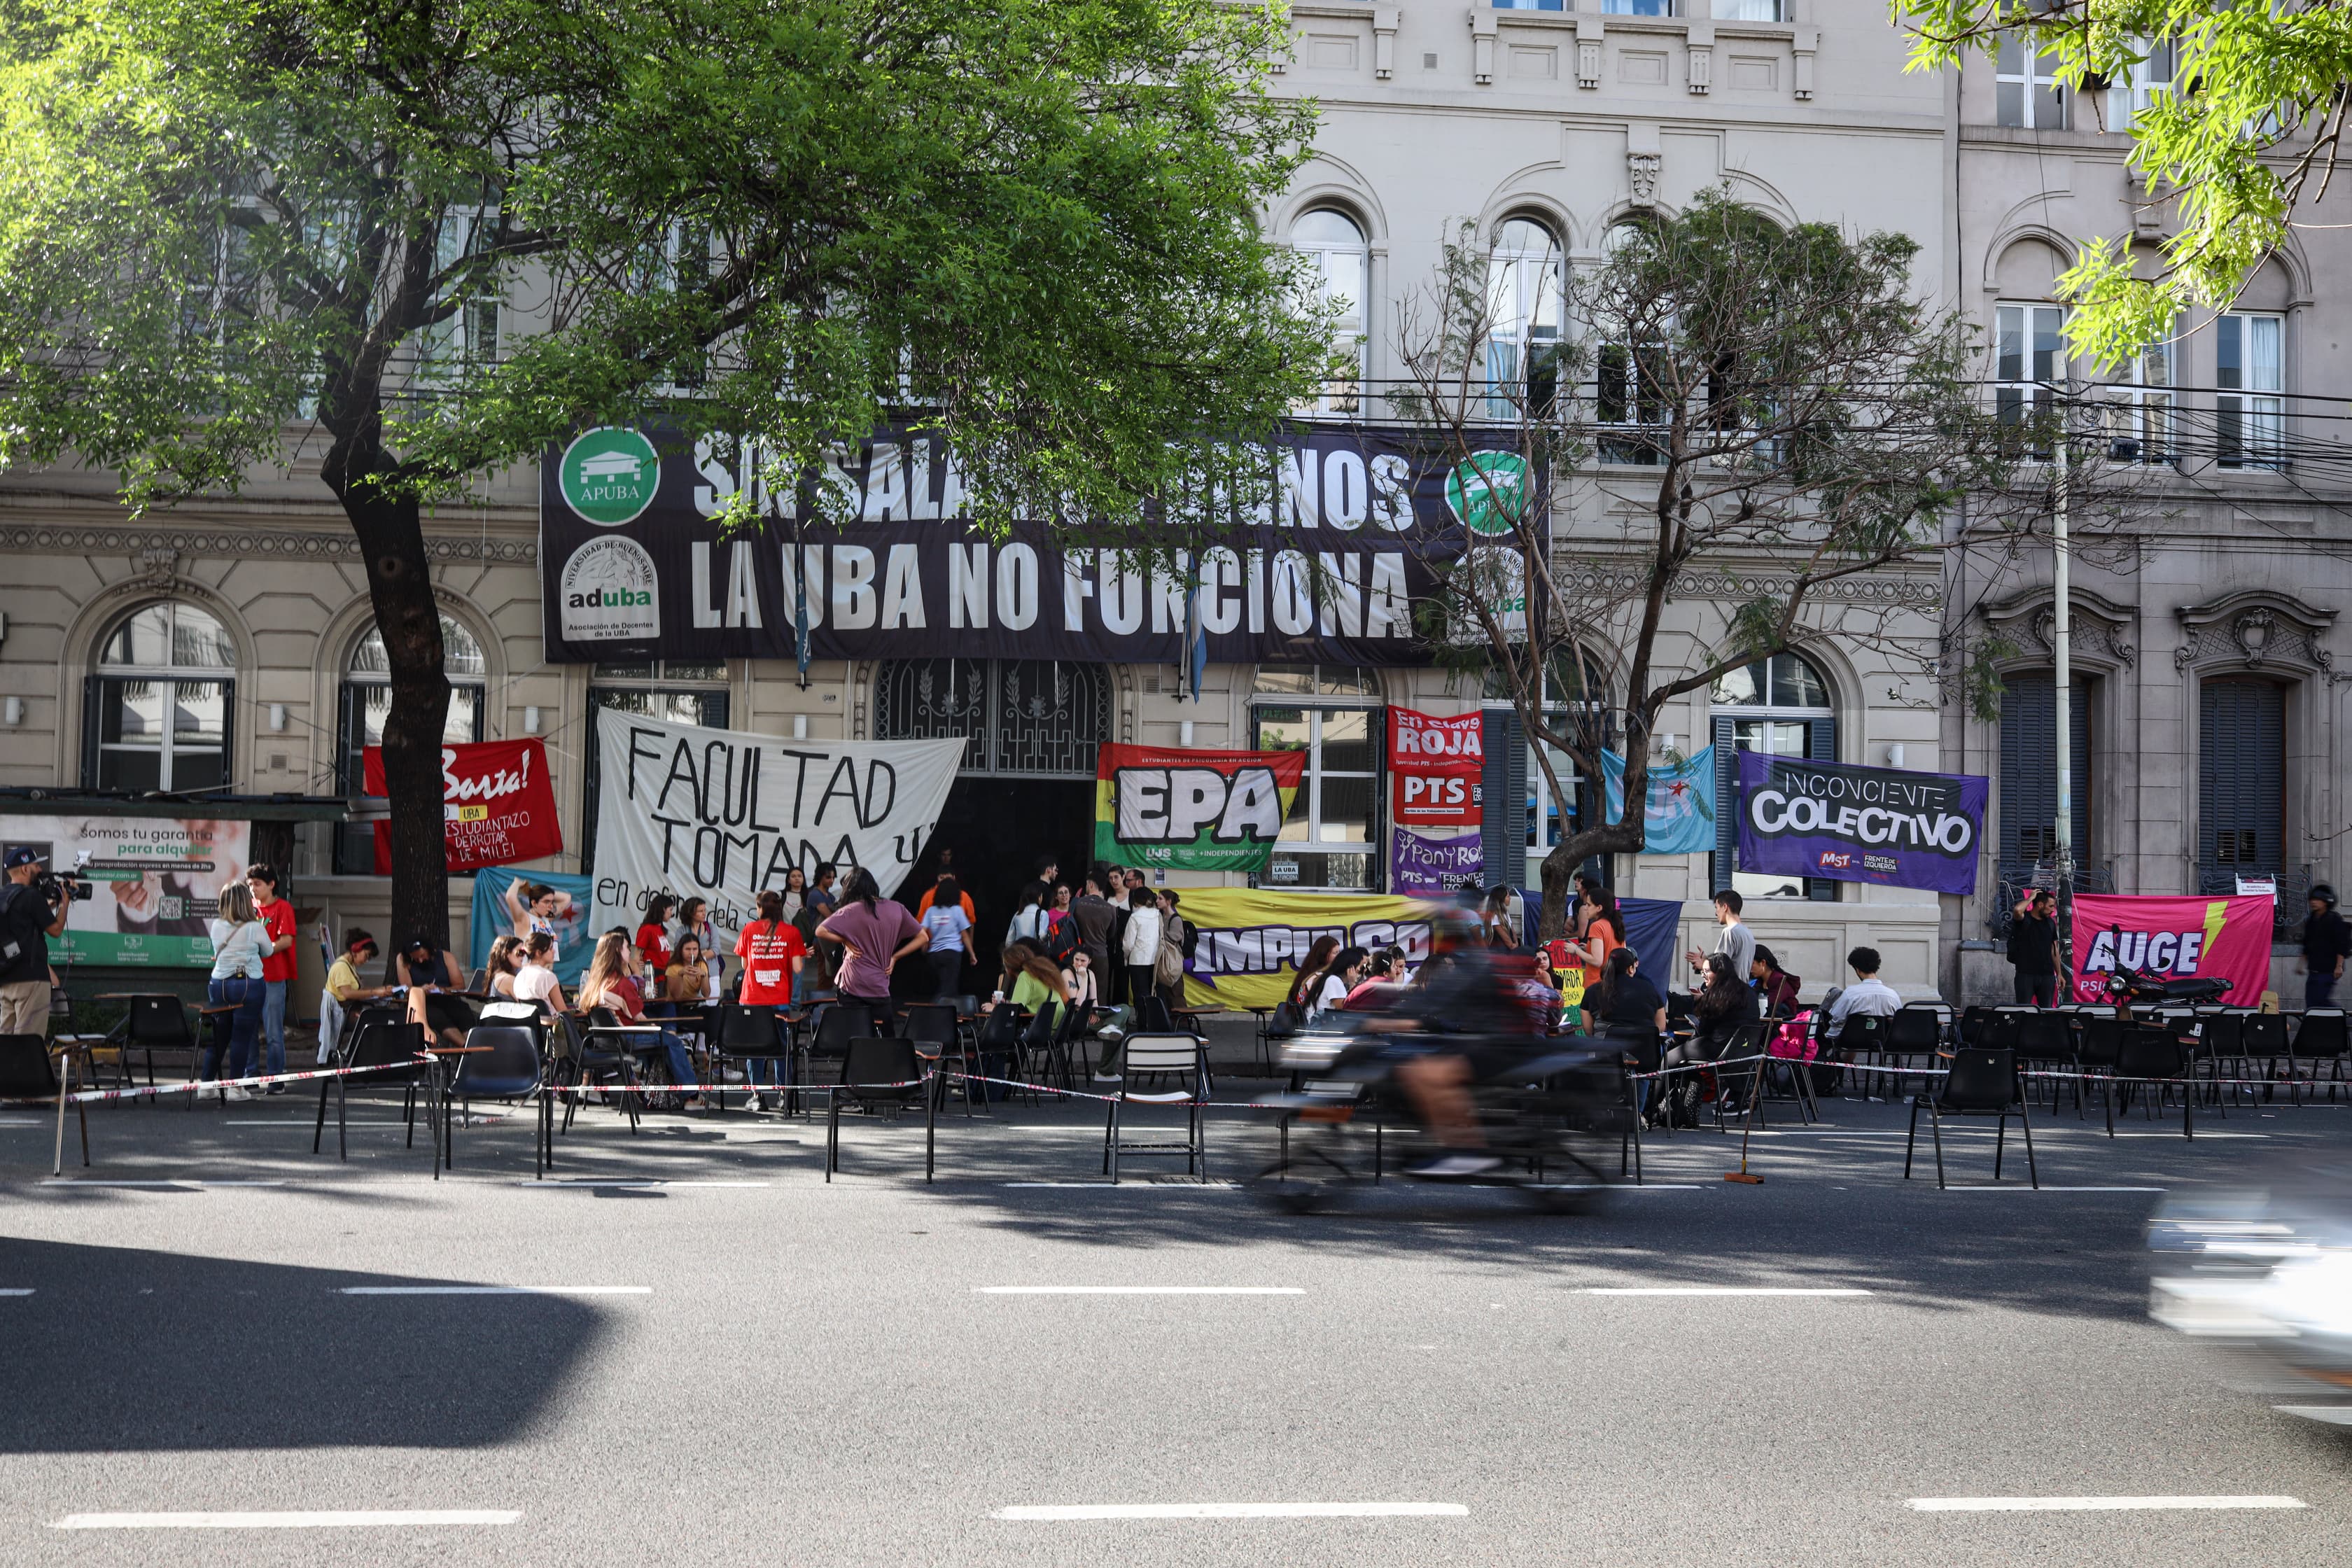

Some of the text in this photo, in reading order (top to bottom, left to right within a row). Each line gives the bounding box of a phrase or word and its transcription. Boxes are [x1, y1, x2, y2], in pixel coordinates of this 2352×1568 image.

[580, 484, 640, 502] APUBA
[568, 587, 652, 609] aduba
[692, 540, 1413, 638] LA UBA NO FUNCIONA
[568, 621, 654, 631] Asociación de Docentes
[1395, 710, 1422, 729] En
[1396, 727, 1482, 756] ROJA
[629, 727, 896, 834] FACULTAD
[1404, 776, 1465, 804] PTS
[1785, 772, 1947, 810] INCONCIENTE
[463, 806, 480, 820] UBA
[1117, 769, 1282, 839] EPA
[444, 811, 531, 838] ESTUDIANTAZO
[1751, 789, 1971, 853] COLECTIVO
[80, 828, 129, 839] somos
[133, 829, 147, 839] tu
[455, 832, 508, 848] DERROTAR
[118, 844, 213, 858] para alquilar
[461, 850, 474, 863] DE
[479, 843, 516, 860] MILEI
[650, 813, 859, 892] TOMADA
[1145, 848, 1171, 858] UJS
[1821, 853, 1851, 867] MST
[1864, 855, 1889, 863] FRENTE
[94, 861, 138, 869] preaprobación
[1863, 862, 1897, 870] IZQUIERDA
[1401, 870, 1422, 883] PTS
[596, 877, 629, 908] en
[2085, 930, 2203, 972] AUGE
